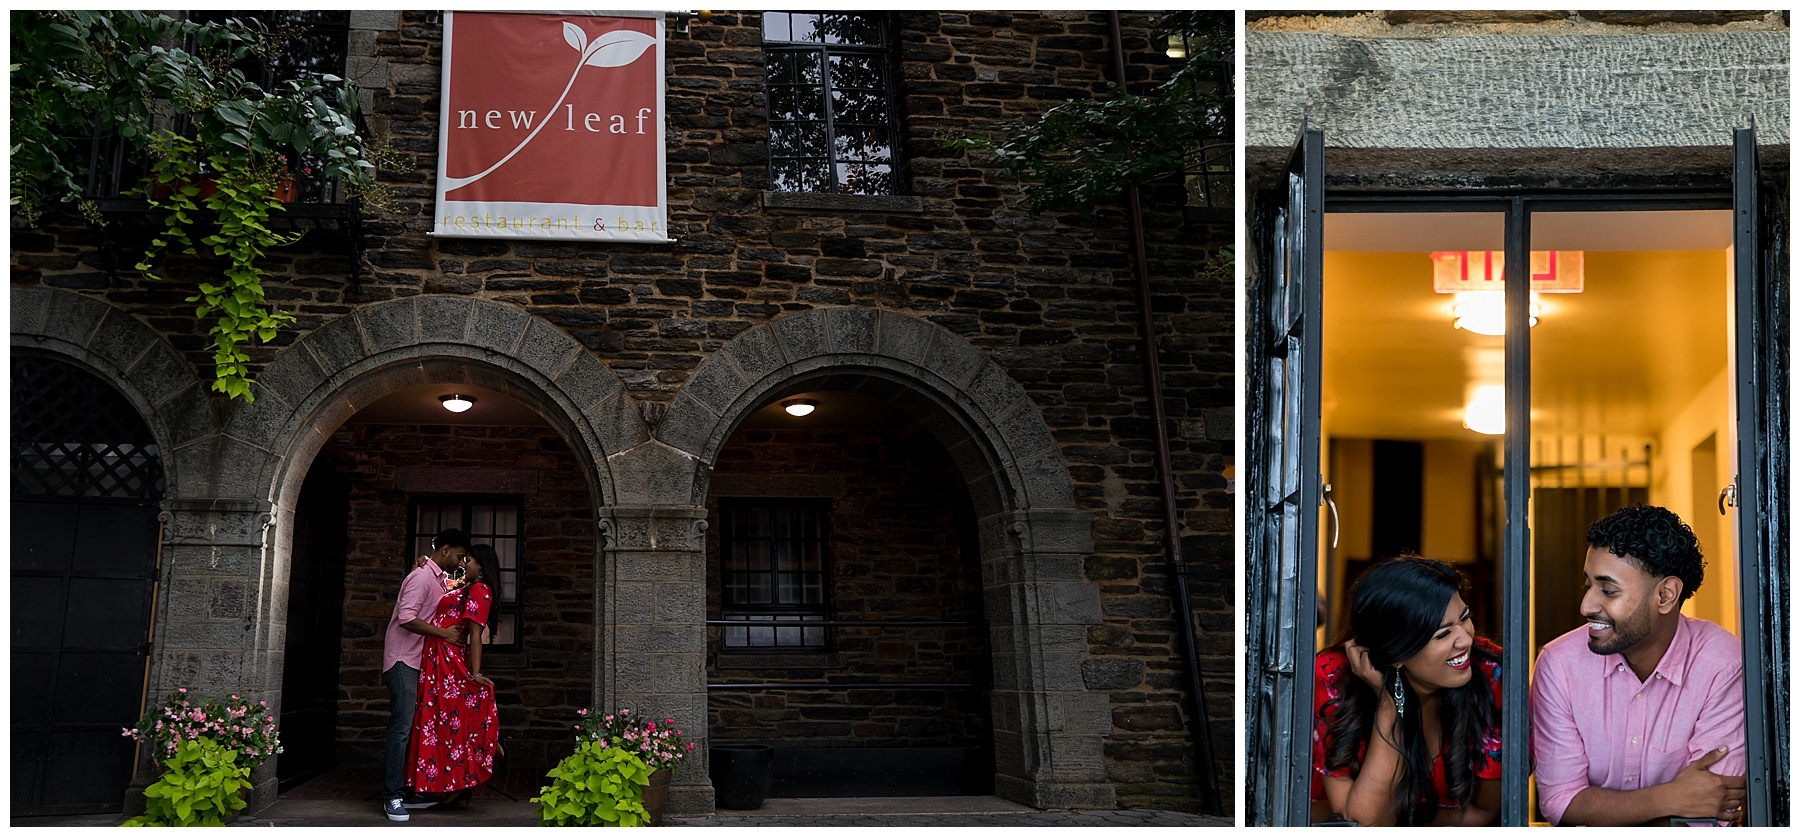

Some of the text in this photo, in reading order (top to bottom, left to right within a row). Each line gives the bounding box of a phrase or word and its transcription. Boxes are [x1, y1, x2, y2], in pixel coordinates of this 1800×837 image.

[457, 103, 652, 135] new leaf
[443, 212, 659, 233] restaurant & bar
